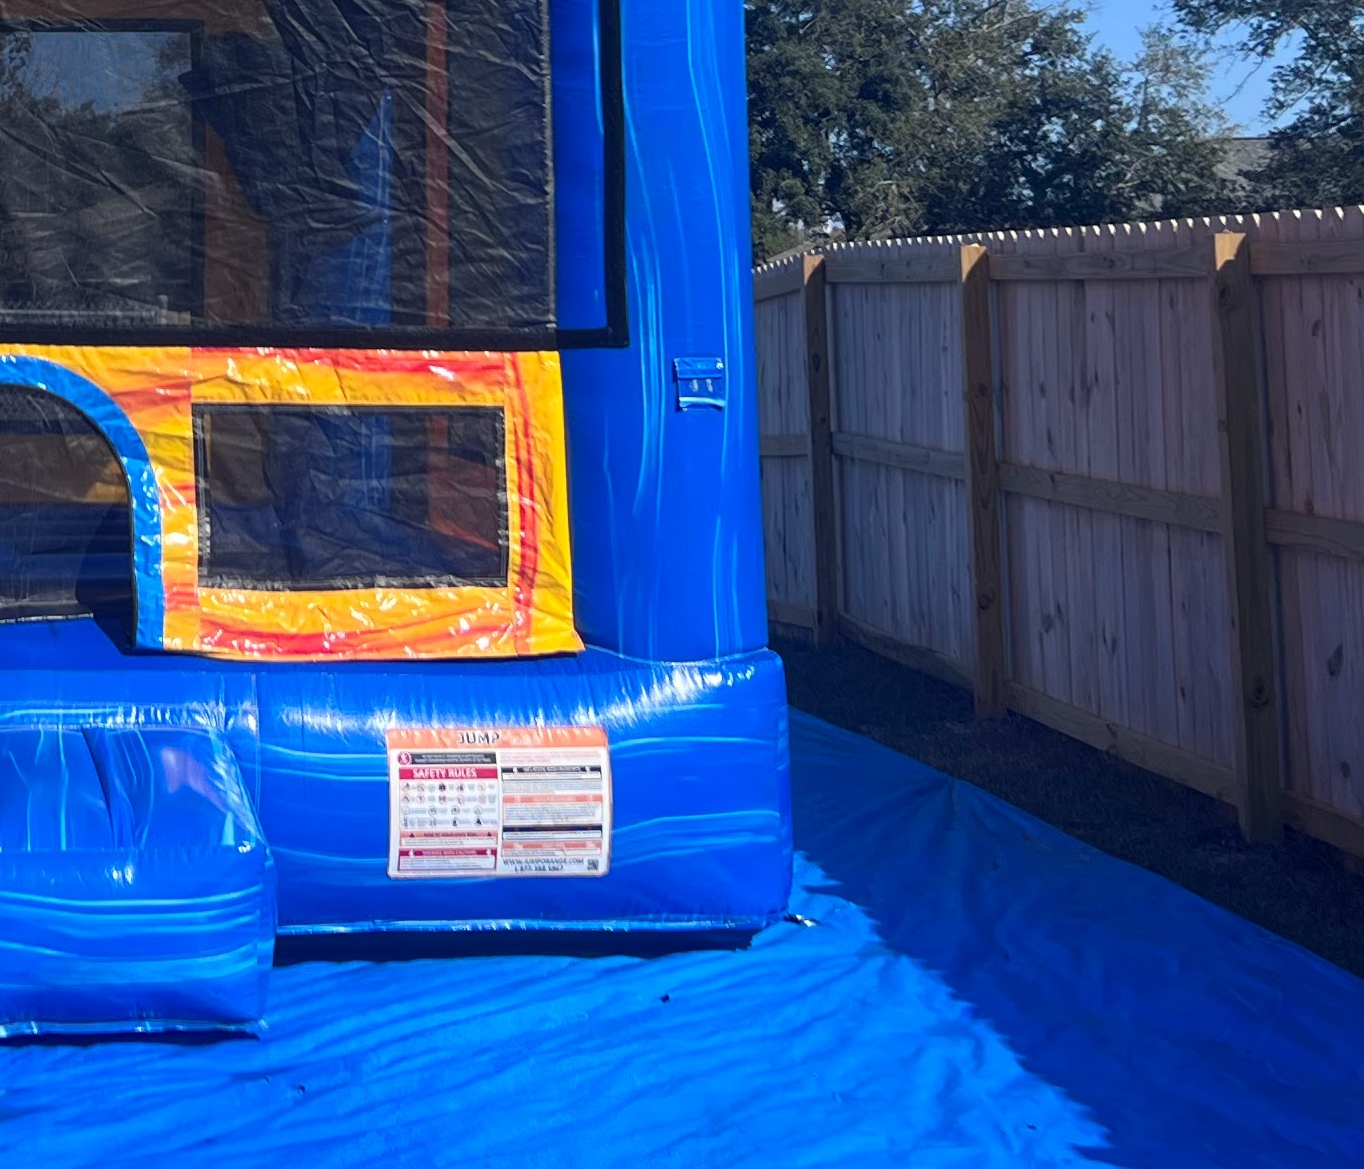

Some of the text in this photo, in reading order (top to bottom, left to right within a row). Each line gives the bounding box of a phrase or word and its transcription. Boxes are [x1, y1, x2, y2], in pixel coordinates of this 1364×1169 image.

[458, 732, 500, 745] JUMP
[413, 768, 478, 779] SAFETY RULES
